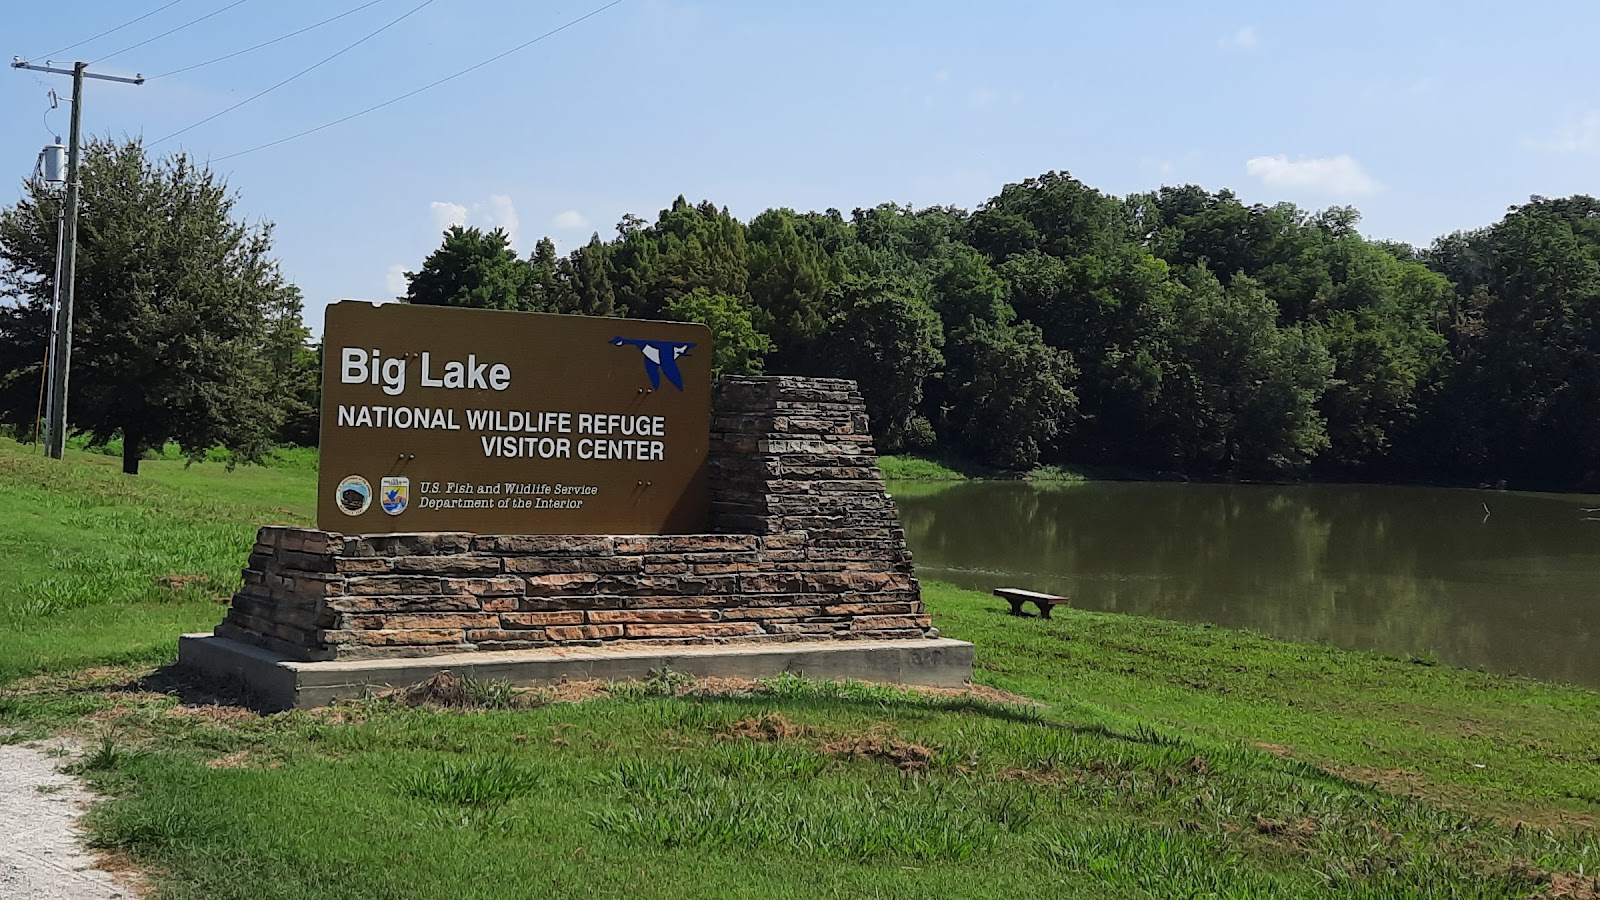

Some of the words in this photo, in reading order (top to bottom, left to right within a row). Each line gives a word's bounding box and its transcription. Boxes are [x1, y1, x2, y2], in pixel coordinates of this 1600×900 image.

[341, 347, 406, 395] Big
[421, 351, 511, 391] Lake
[337, 405, 460, 430] NATIONAL
[466, 409, 572, 433] WILDLIFE
[578, 413, 665, 437] REFUGE
[481, 436, 570, 459] VISITOR
[577, 438, 664, 461] CENTER
[420, 482, 441, 494] U.S.
[445, 482, 474, 494] Fish
[476, 482, 501, 495] and
[504, 483, 552, 495] Wildlife
[553, 484, 598, 495] Service
[418, 496, 495, 510] Department
[497, 497, 511, 509] of
[512, 497, 532, 509] the
[534, 497, 583, 509] Interior
